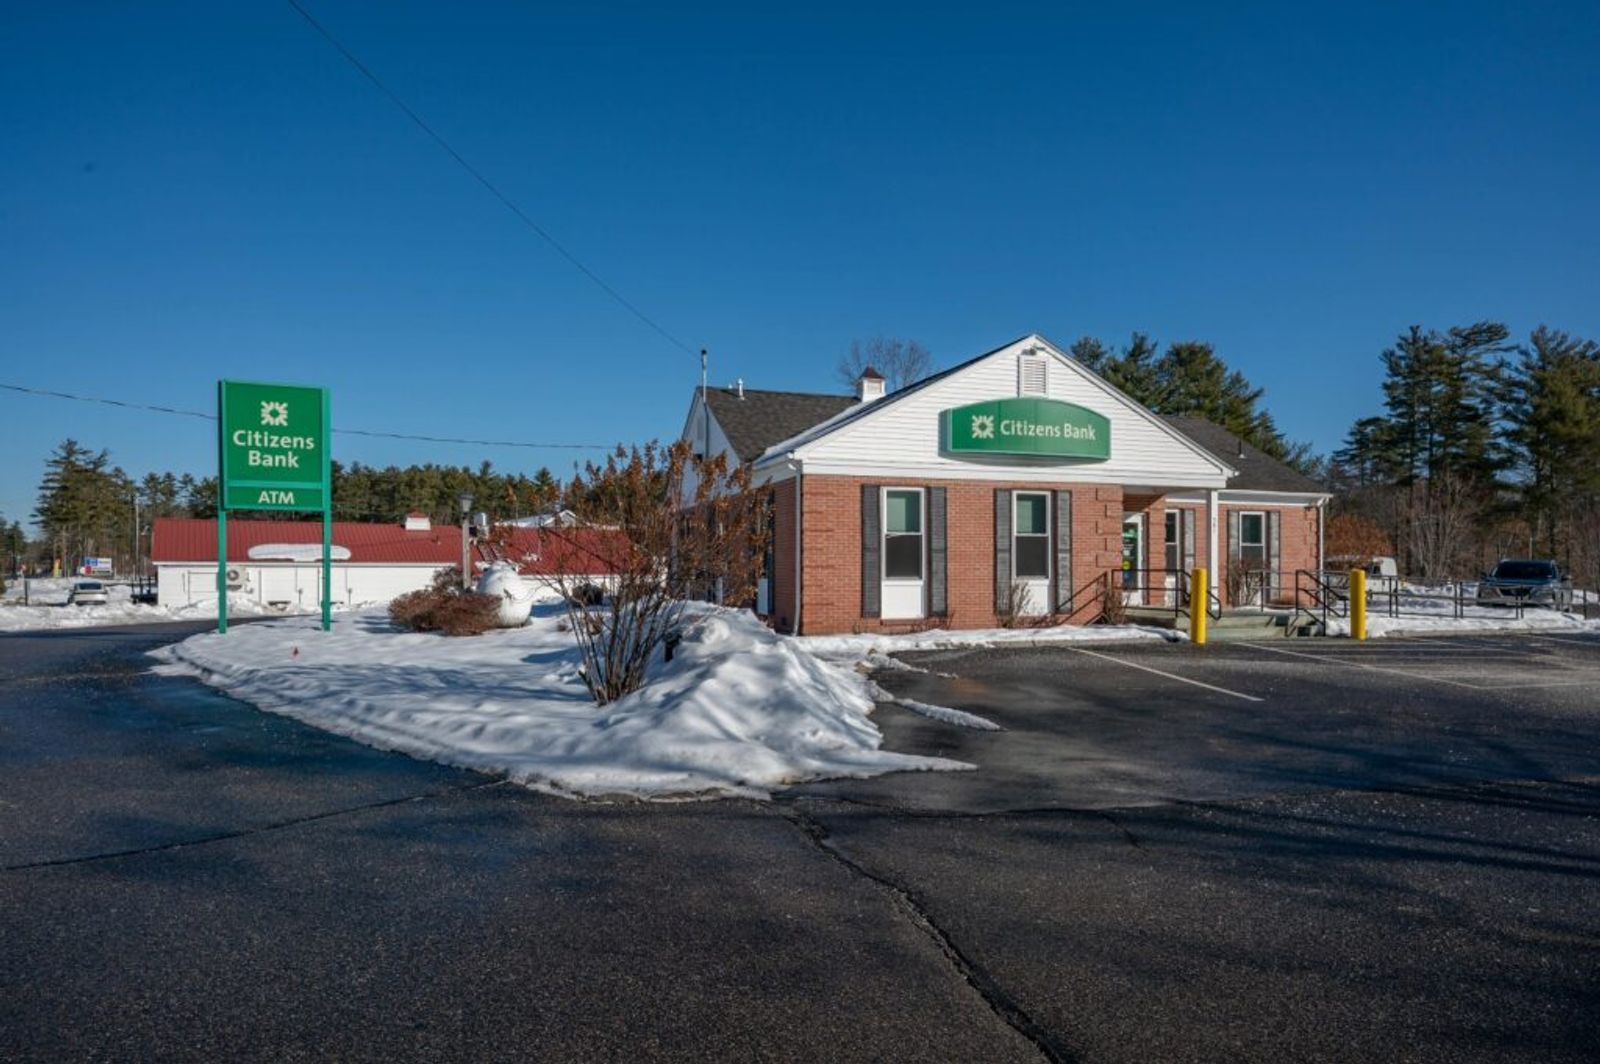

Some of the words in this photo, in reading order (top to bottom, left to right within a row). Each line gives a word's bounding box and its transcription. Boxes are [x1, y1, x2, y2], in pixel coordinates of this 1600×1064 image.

[1000, 420, 1061, 437] Citizens
[1063, 423, 1096, 440] Bank
[233, 430, 315, 450] Citizens
[248, 450, 299, 468] Bank
[258, 491, 295, 504] ATM
